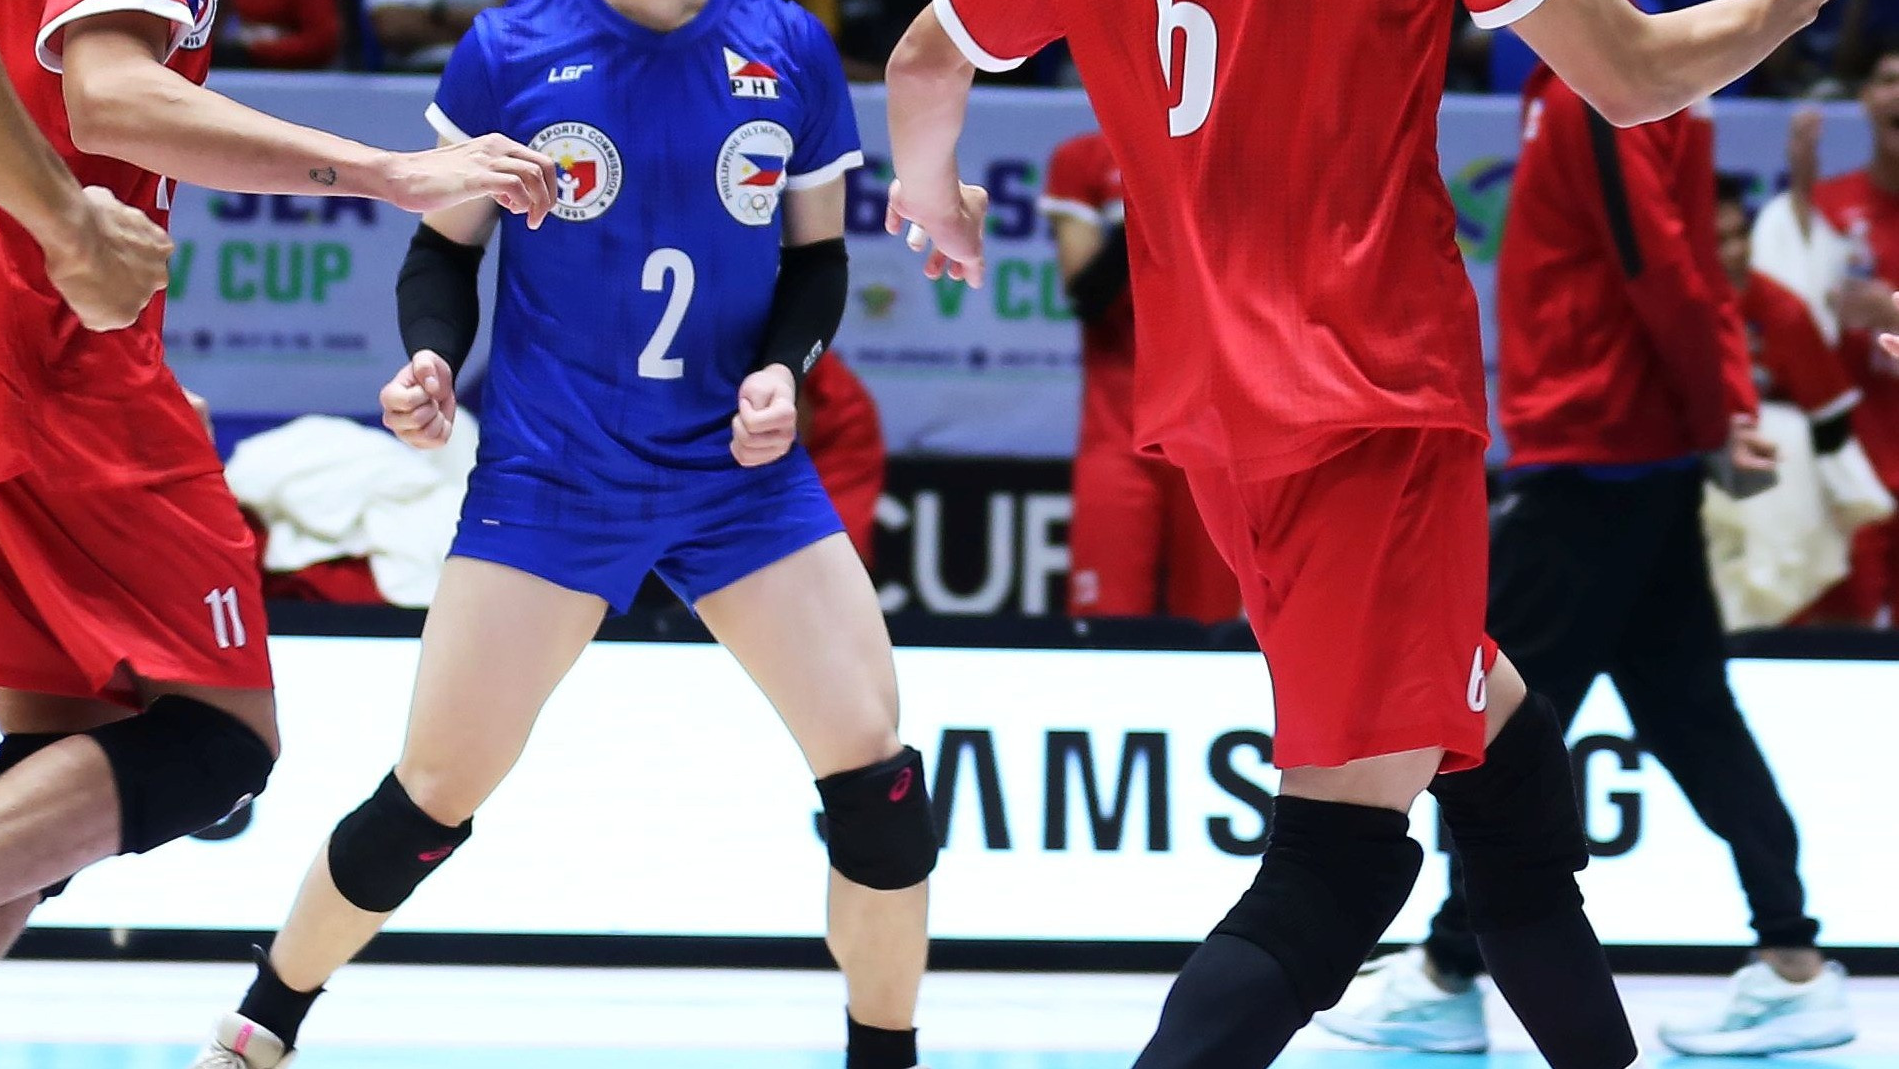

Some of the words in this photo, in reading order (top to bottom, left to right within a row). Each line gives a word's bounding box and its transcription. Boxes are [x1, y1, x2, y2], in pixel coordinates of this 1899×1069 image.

[539, 125, 584, 142] SPORTS
[588, 130, 620, 198] COMMISSION
[720, 136, 742, 200] PHILIPPINE
[218, 240, 353, 303] CUP
[635, 247, 696, 380] 2
[204, 586, 247, 649] 11
